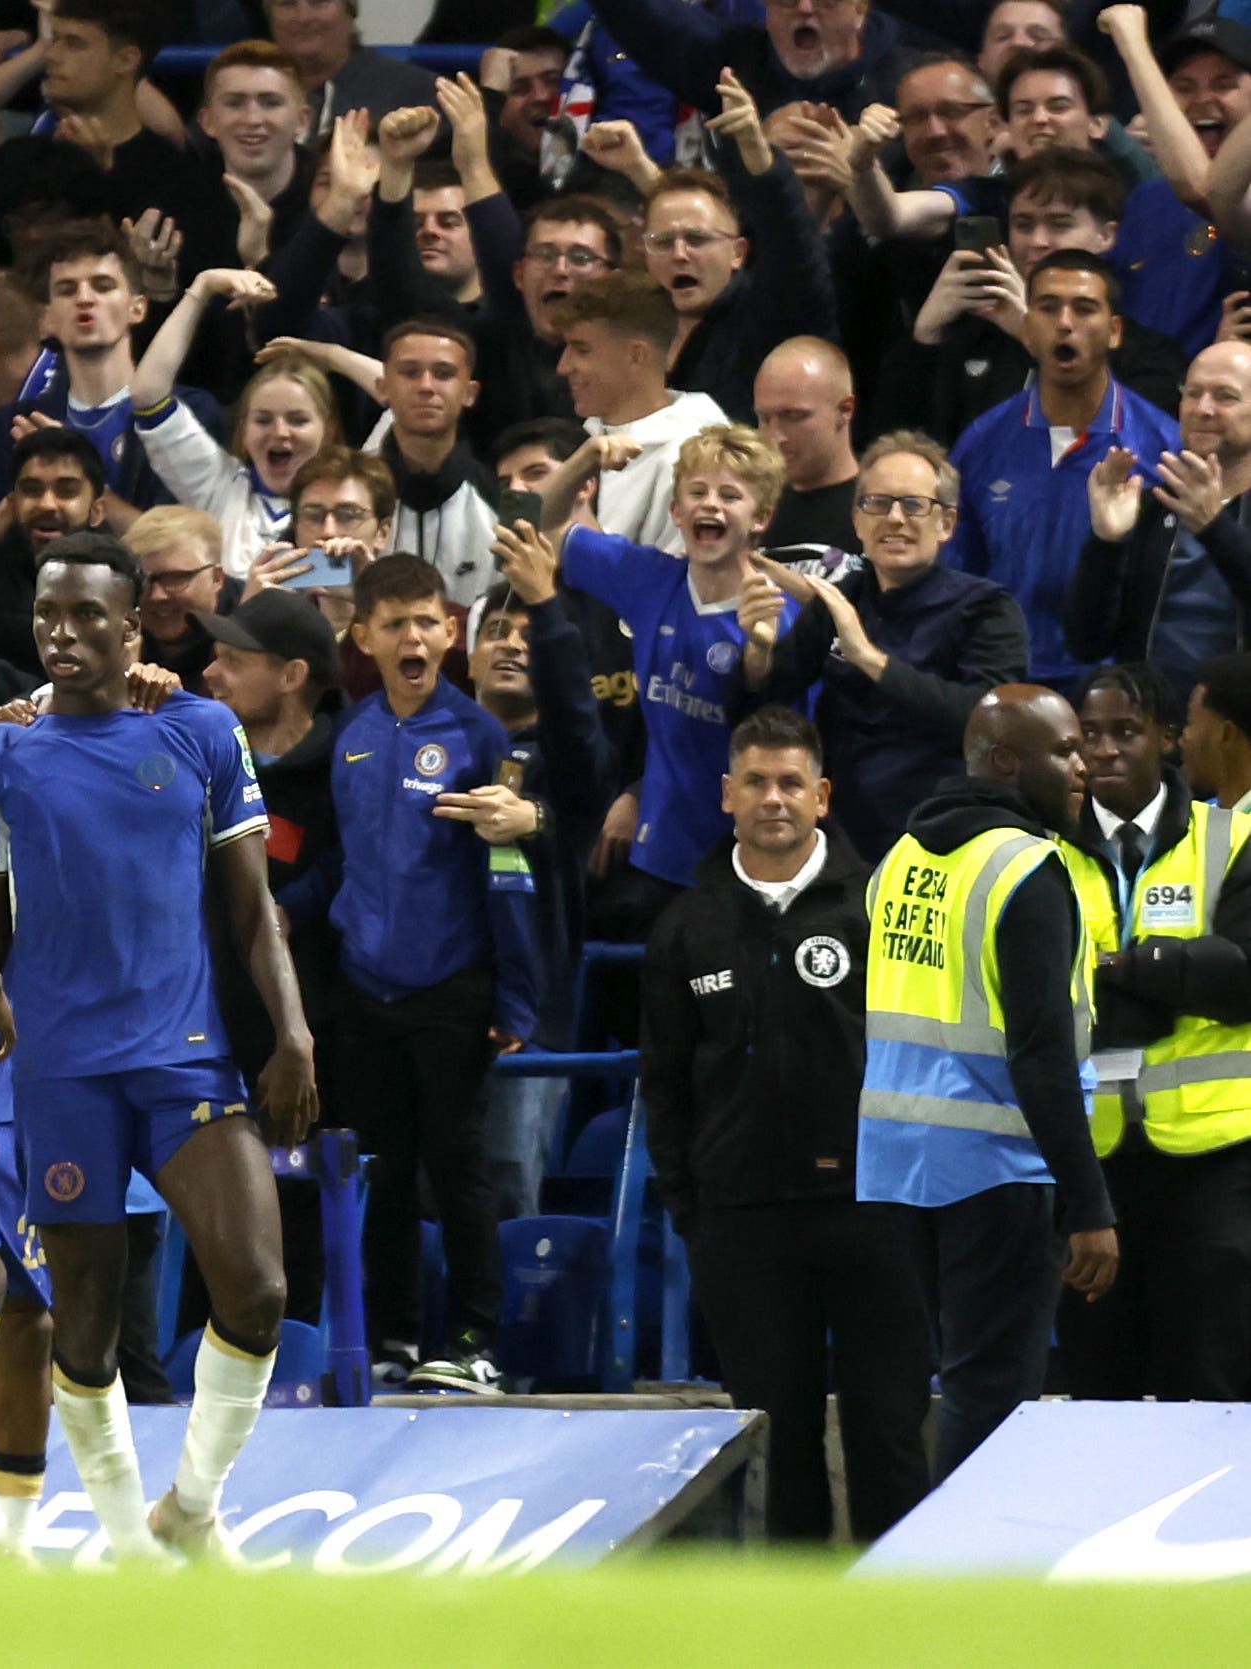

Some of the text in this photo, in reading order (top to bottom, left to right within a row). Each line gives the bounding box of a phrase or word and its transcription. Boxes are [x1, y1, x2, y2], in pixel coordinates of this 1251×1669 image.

[647, 675, 725, 724] Emirates
[403, 777, 444, 795] trivago
[1146, 885, 1192, 905] 694
[688, 969, 733, 996] FIRE
